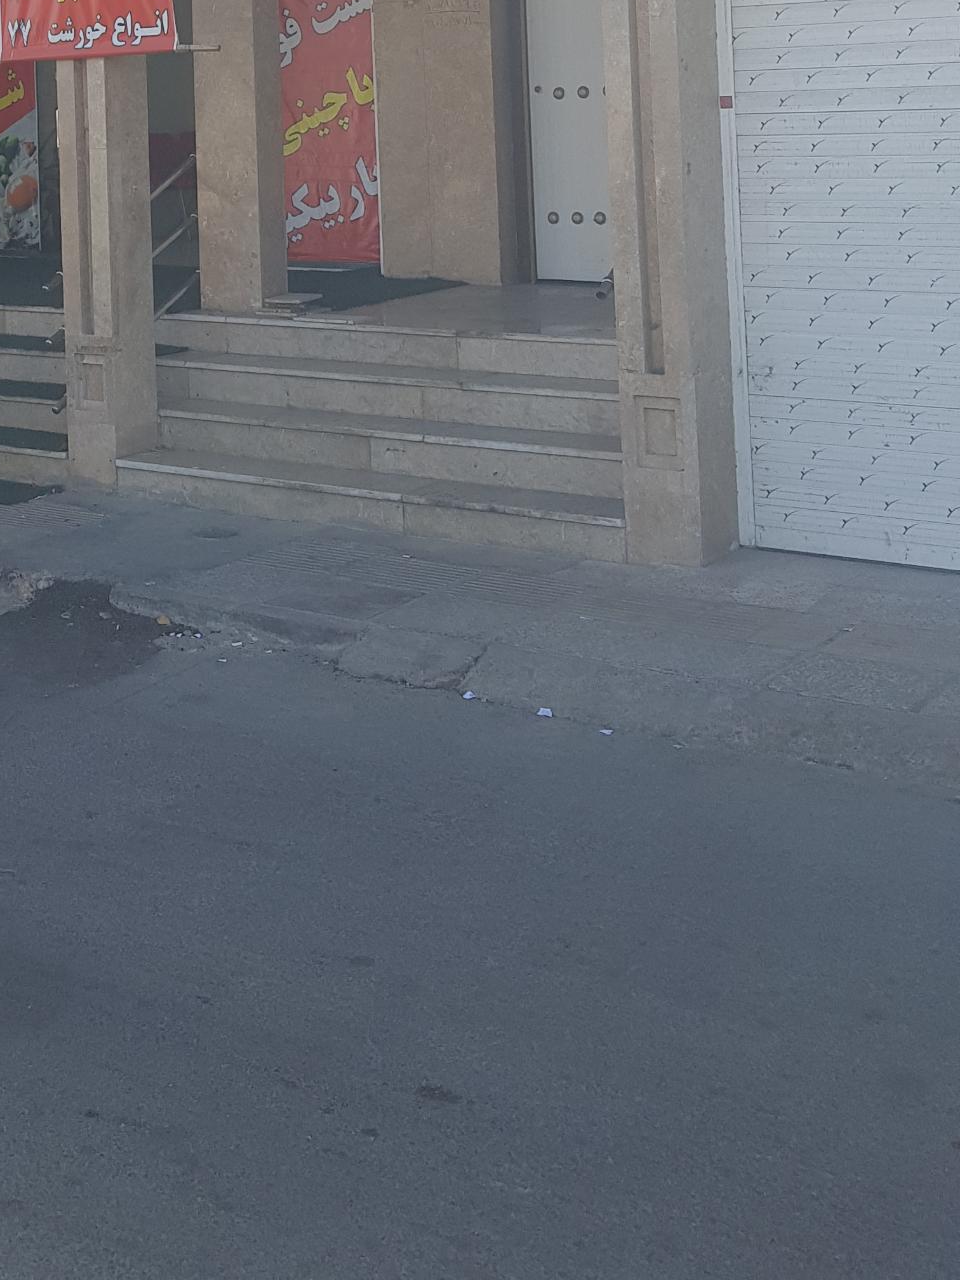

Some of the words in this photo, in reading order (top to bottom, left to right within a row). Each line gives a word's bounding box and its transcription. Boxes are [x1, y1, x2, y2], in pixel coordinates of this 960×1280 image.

[47, 13, 107, 49] خورشت
[111, 9, 169, 47] انواع
[280, 8, 303, 67] فو
